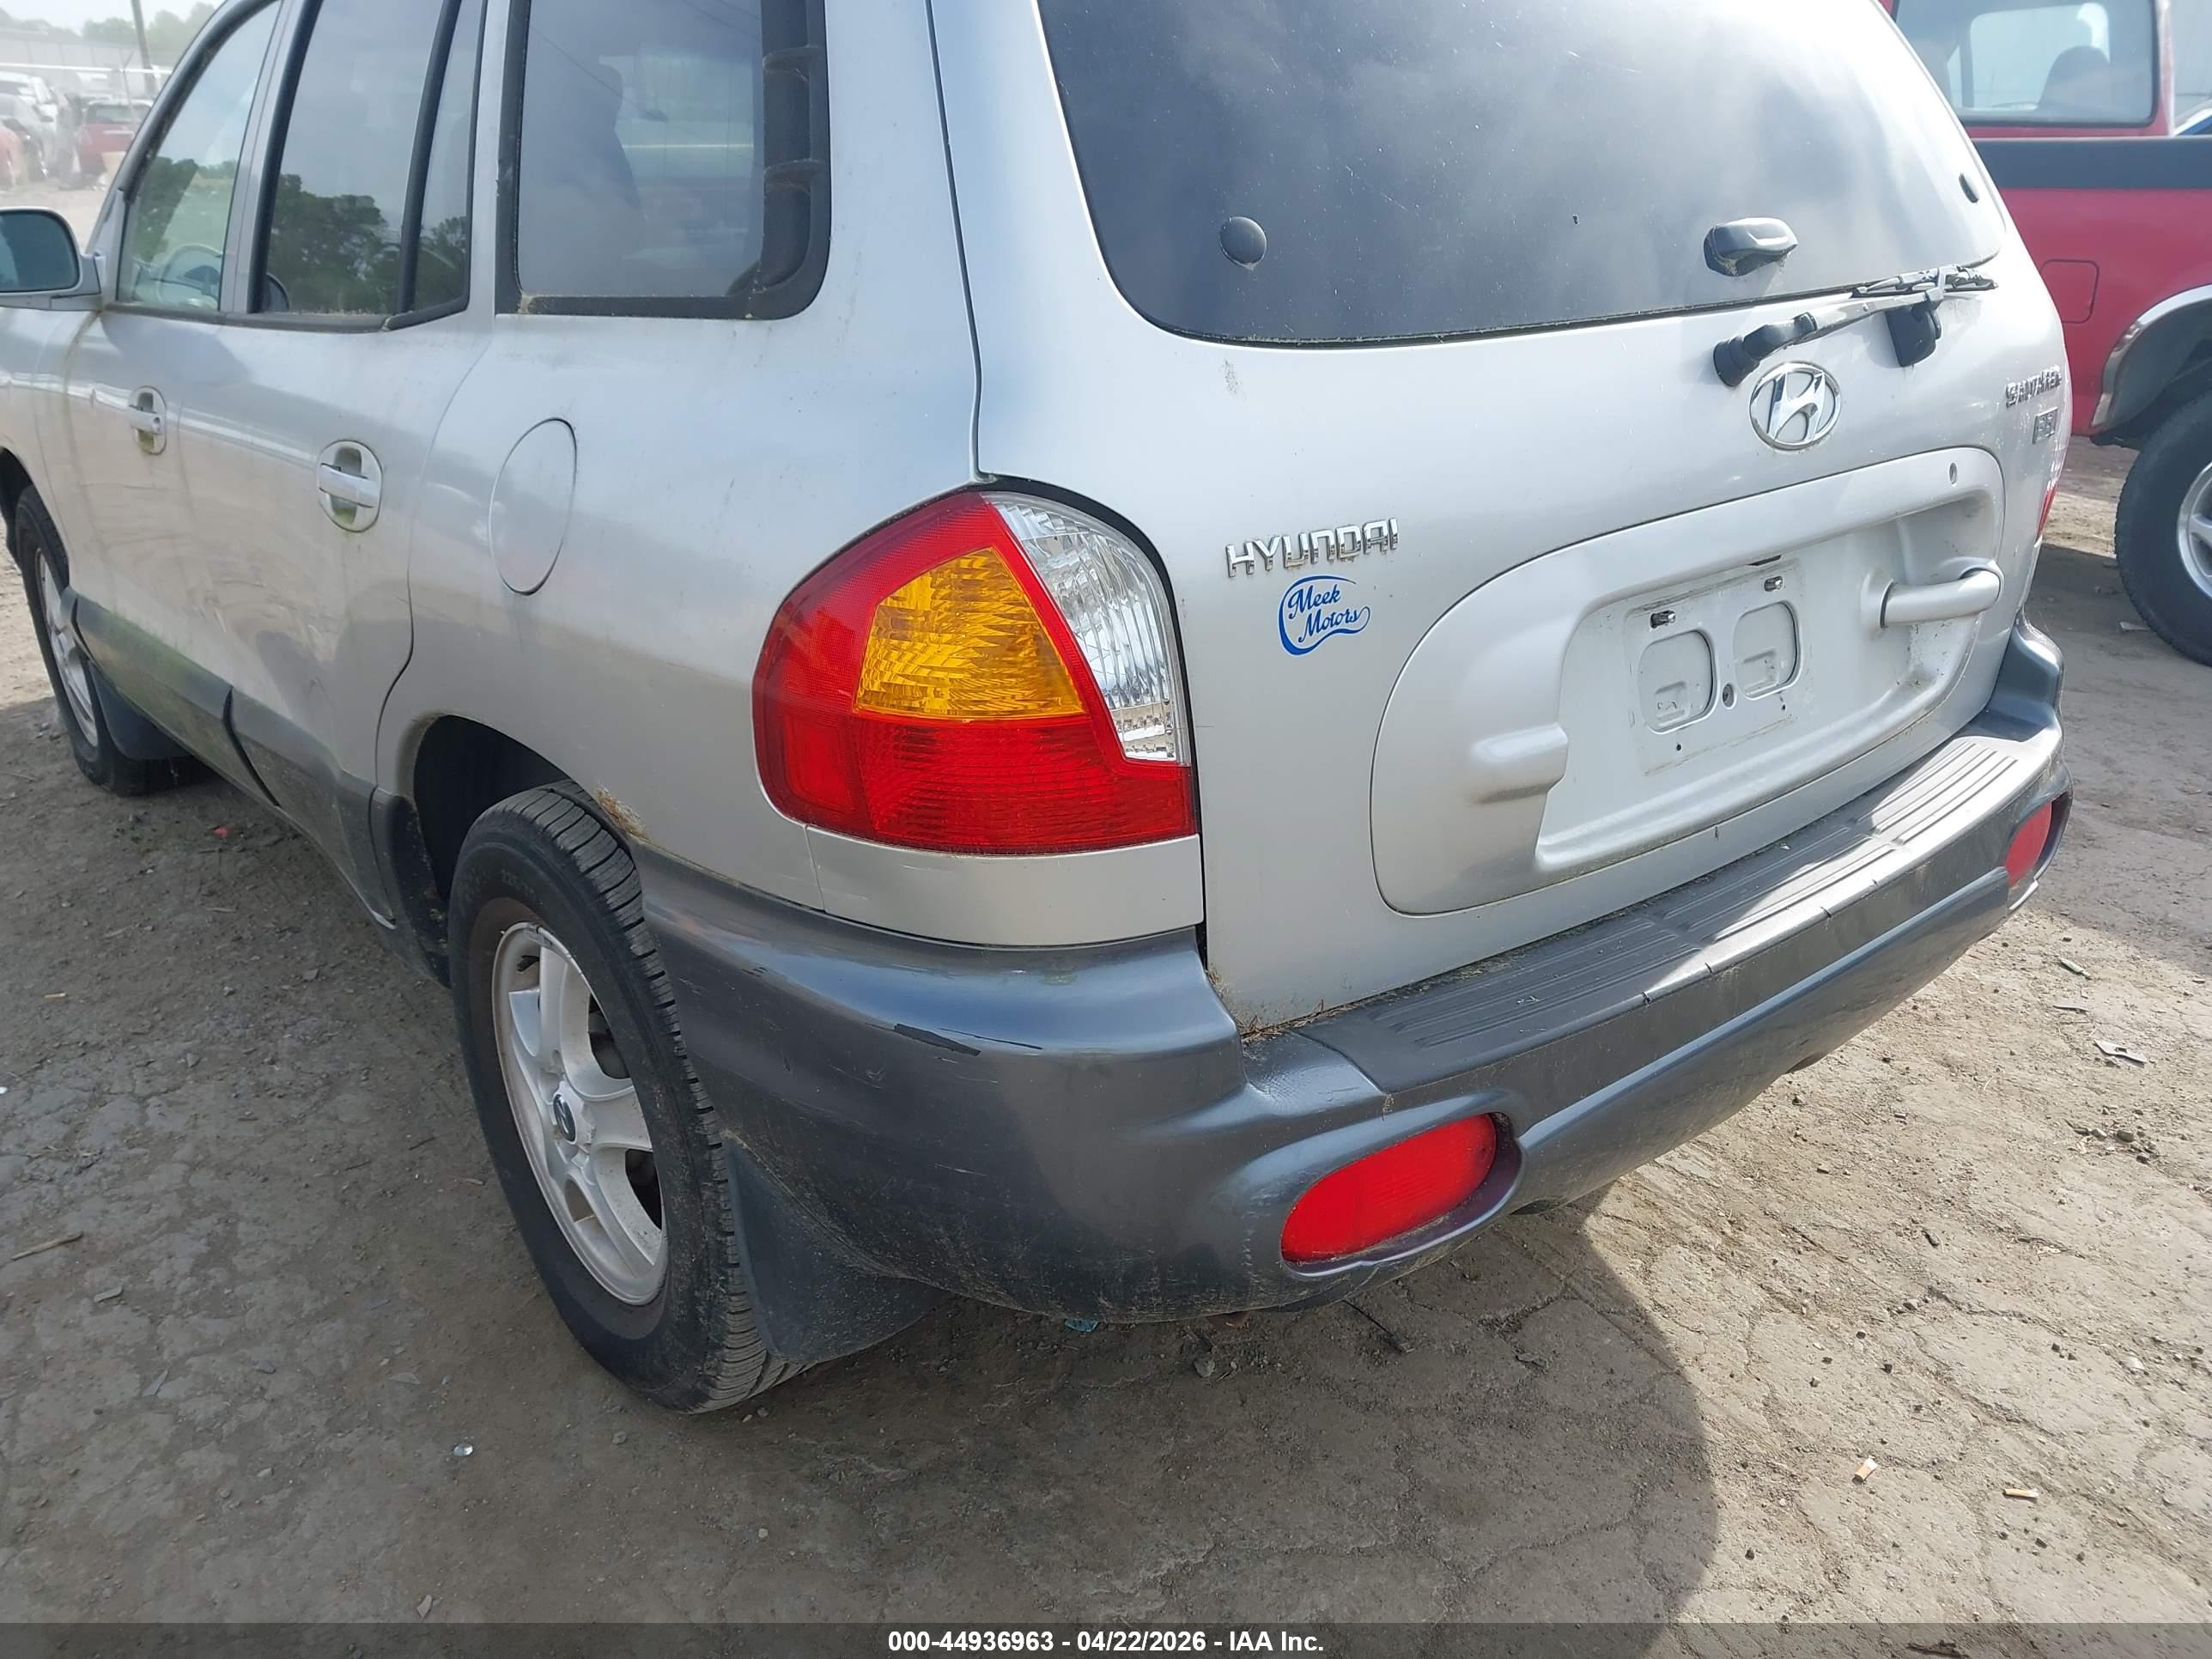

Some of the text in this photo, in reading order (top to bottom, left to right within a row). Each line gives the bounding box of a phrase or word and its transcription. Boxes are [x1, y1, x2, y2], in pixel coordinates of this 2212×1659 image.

[1225, 518, 1399, 578] HYUNDAI
[1287, 584, 1341, 620] Meek
[1297, 608, 1361, 643] Motors
